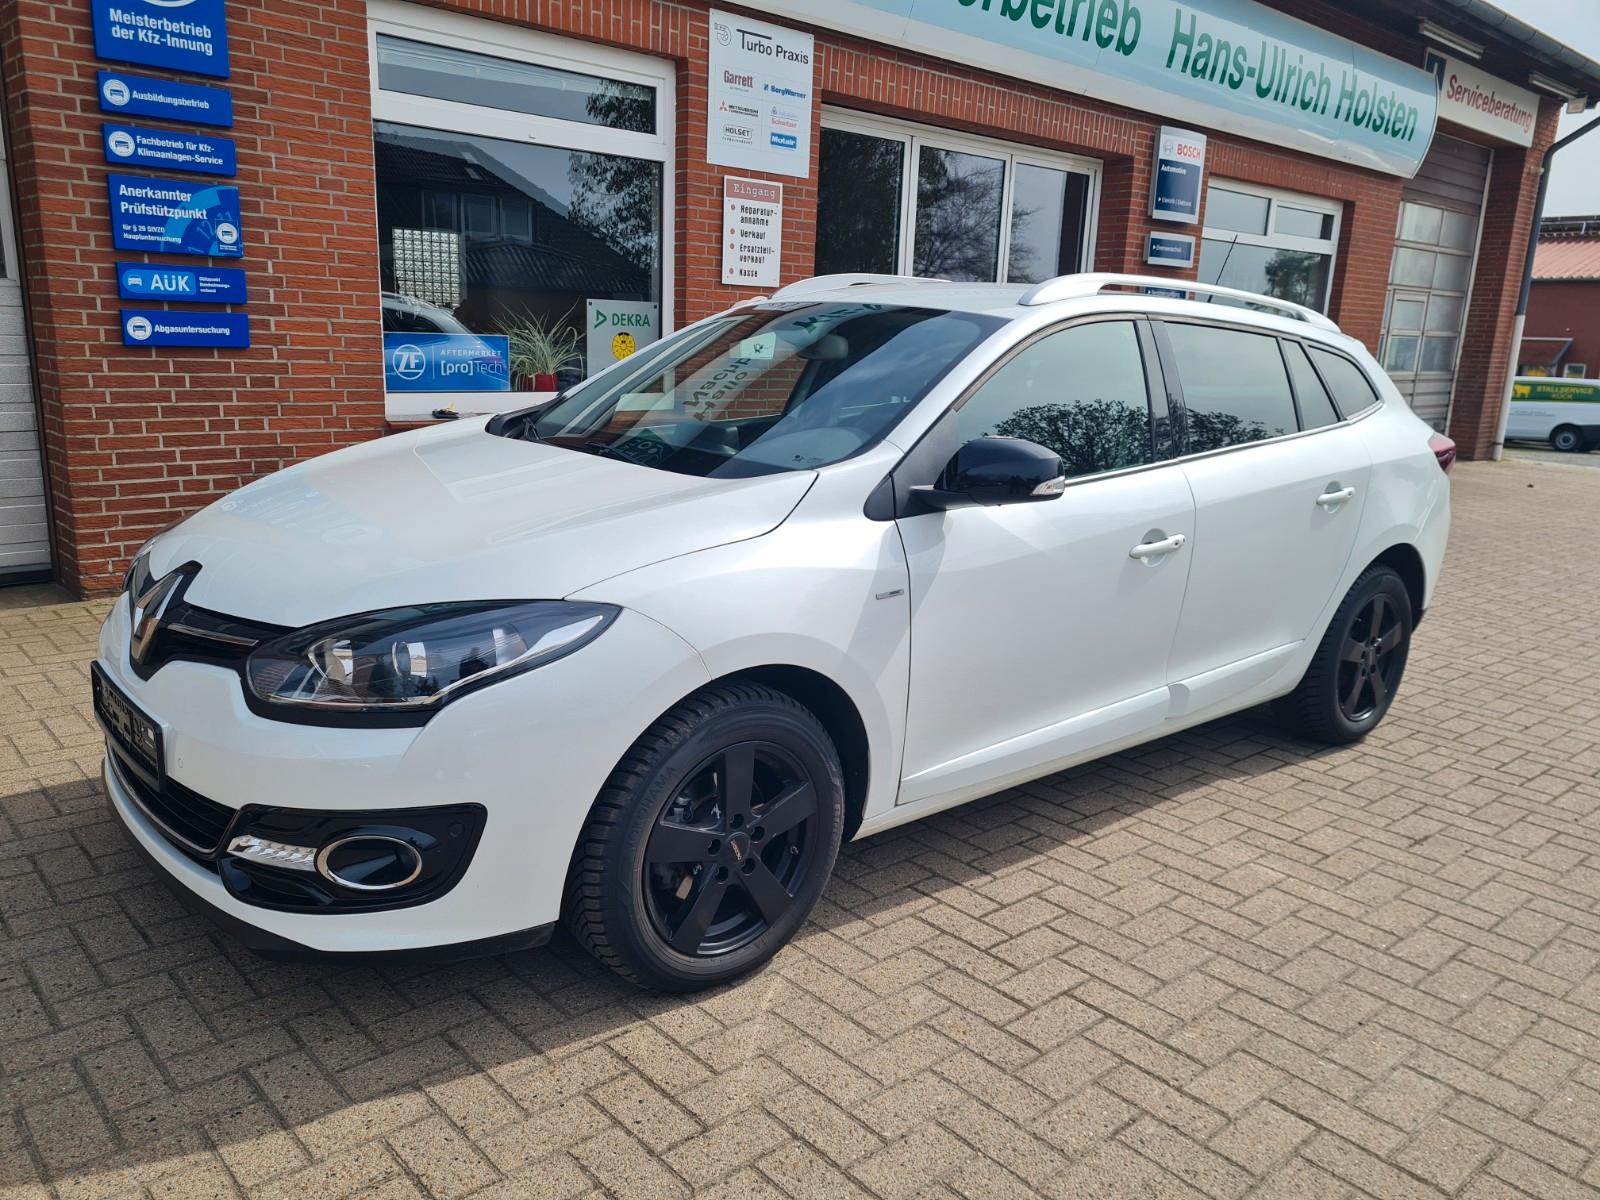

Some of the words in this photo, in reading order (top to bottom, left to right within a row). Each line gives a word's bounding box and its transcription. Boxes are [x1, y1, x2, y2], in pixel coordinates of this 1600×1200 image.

[109, 8, 212, 39] Meisterbetrieb
[111, 25, 135, 40] der
[138, 28, 213, 56] Kfz-Innung
[736, 28, 773, 56] Turbo
[775, 45, 809, 64] Praxis
[724, 70, 753, 88] Garrett
[957, 0, 1142, 56] etrieb
[1165, 8, 1332, 116] Hans-Ulrich
[1333, 65, 1419, 142] Holsten
[132, 91, 210, 110] Ausbildungsbetrieb
[770, 85, 807, 100] BorgWarner
[1445, 74, 1533, 134] Serviceberatung
[725, 126, 751, 137] HOLSET
[136, 135, 184, 150] Fachbetrieb
[186, 141, 198, 151] für
[199, 143, 215, 153] Kfz-
[1176, 143, 1201, 159] BOSCH
[137, 147, 223, 165] Klimaanlagen-Service
[119, 184, 192, 202] Anerkannter
[733, 183, 776, 200] Eingang
[120, 202, 207, 220] Prüfstützpunkt
[740, 205, 777, 216] Reparatur-
[740, 216, 769, 226] annahme
[123, 232, 182, 244] Hauptuntersuchung
[740, 229, 766, 240] Verkauf
[739, 243, 775, 255] Ersatzteil-
[739, 268, 758, 277] Kasse
[150, 273, 190, 292] AÜK
[612, 312, 651, 327] DEKRA
[154, 324, 231, 336] Abgasuntersuchung
[440, 349, 502, 357] AFTERMARKET
